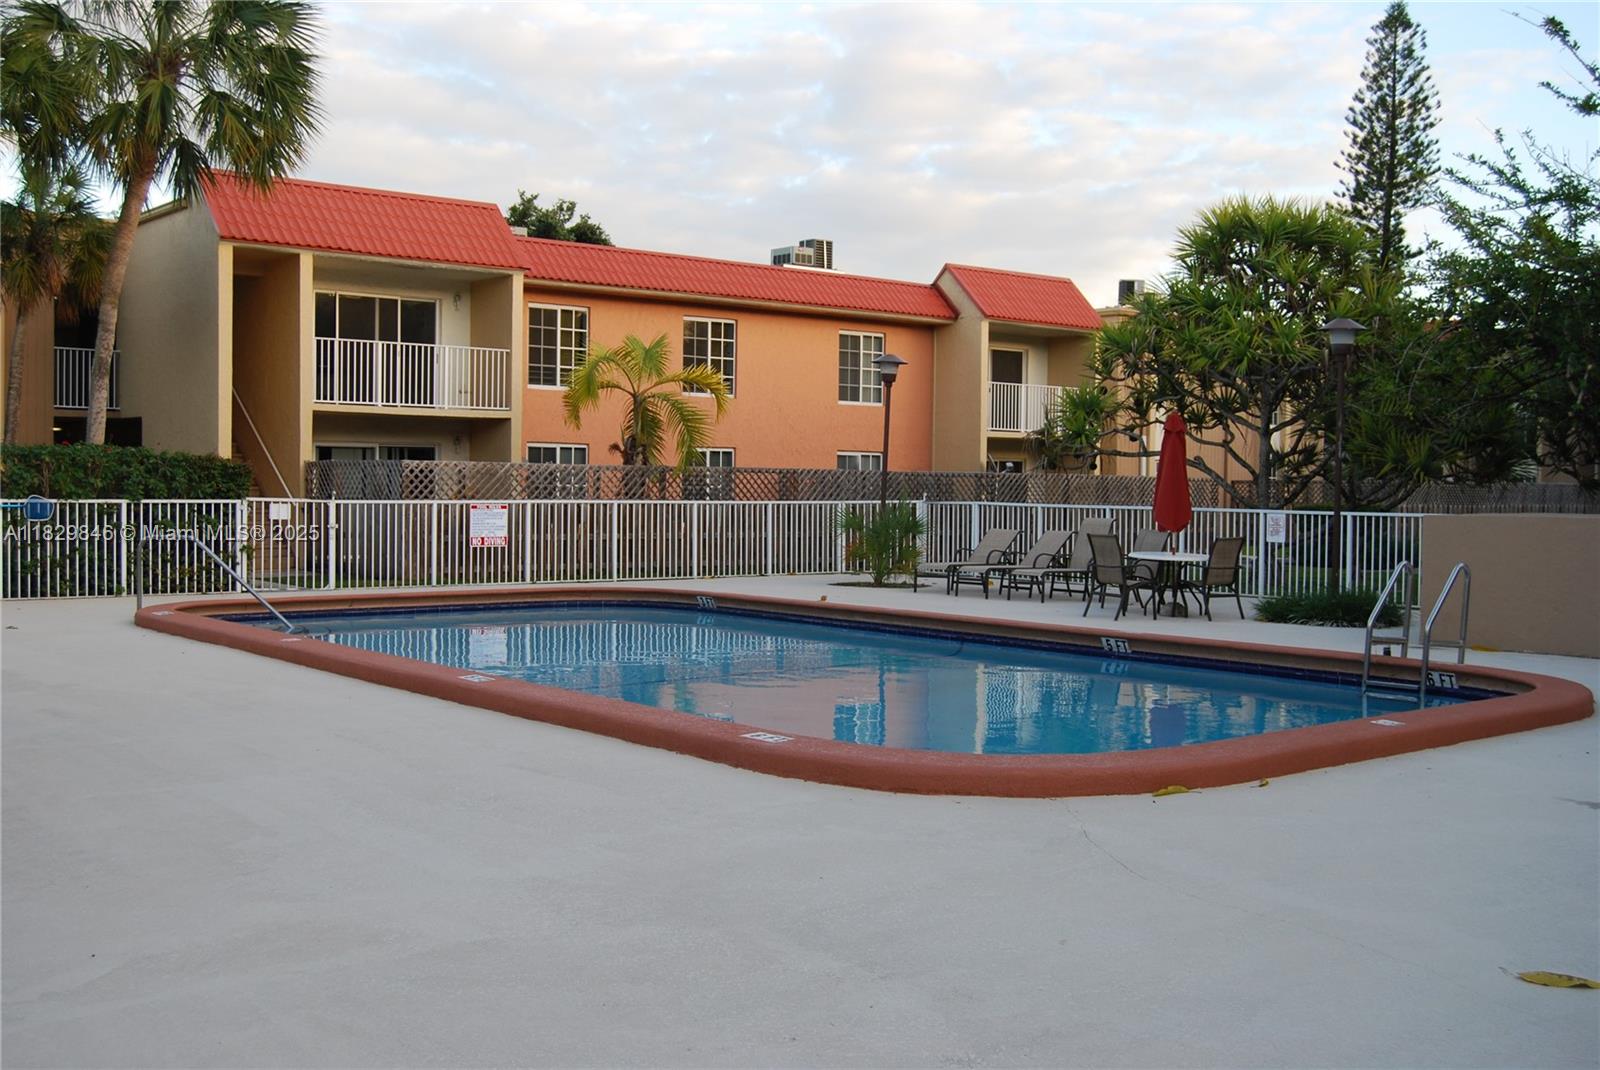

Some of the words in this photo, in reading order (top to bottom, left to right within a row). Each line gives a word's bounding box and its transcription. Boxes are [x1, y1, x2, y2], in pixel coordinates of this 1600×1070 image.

[472, 536, 483, 546] NO
[485, 536, 506, 546] DIVING
[1105, 638, 1113, 652] 5
[1114, 639, 1128, 653] FT
[1426, 672, 1436, 688] 6
[1439, 673, 1454, 688] FT
